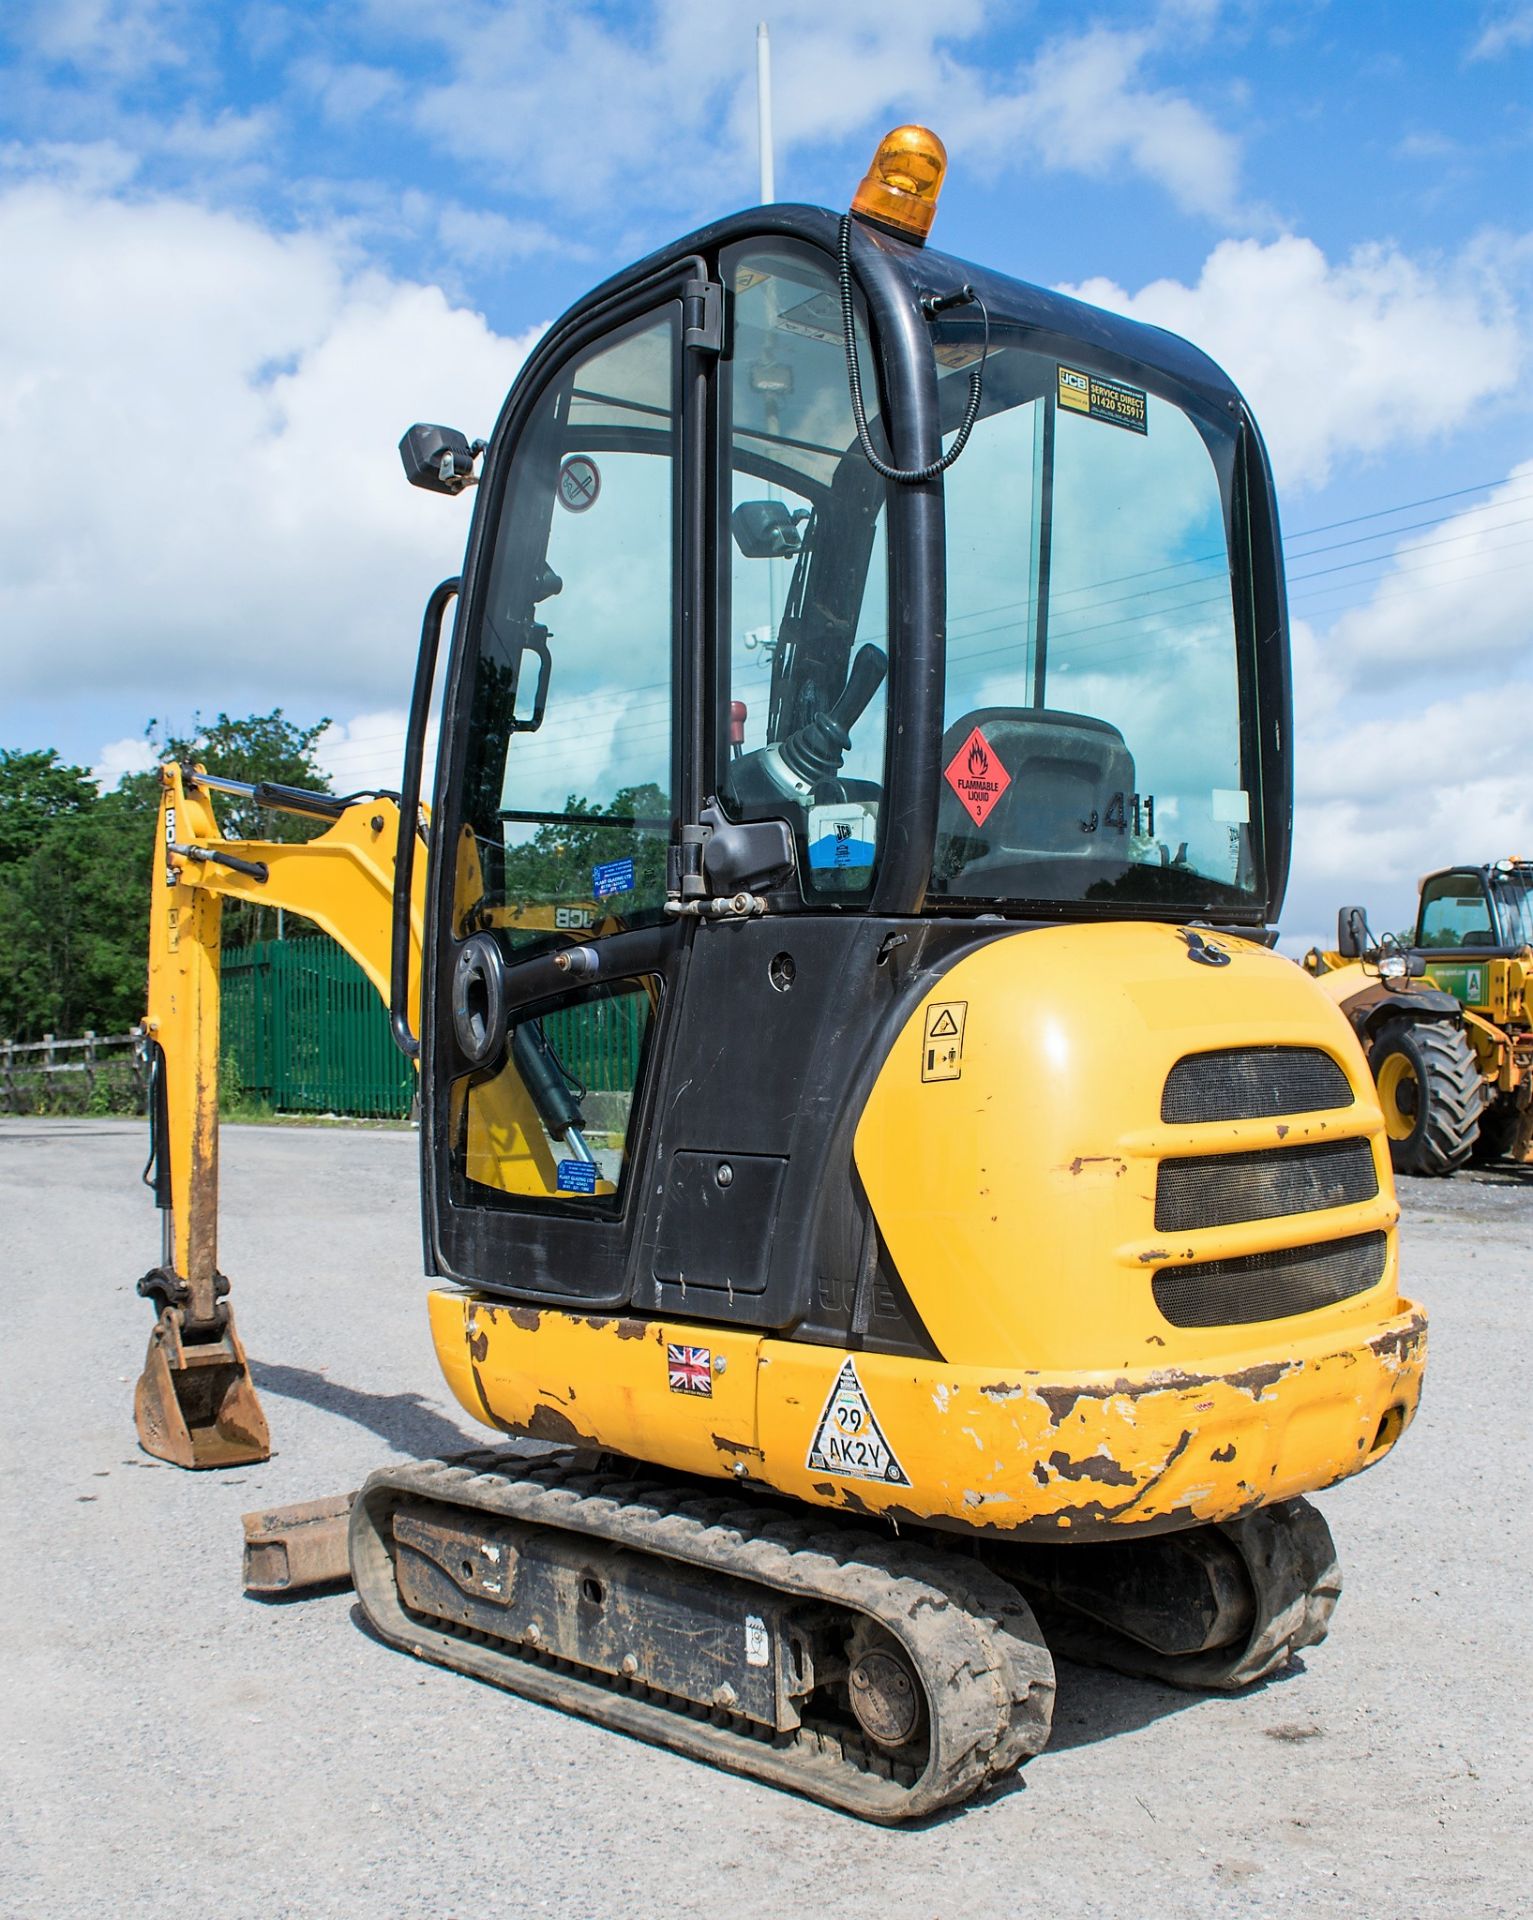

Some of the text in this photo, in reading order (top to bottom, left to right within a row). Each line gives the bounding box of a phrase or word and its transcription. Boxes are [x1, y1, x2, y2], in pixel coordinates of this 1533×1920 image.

[1061, 372, 1086, 390] JCB
[1090, 384, 1119, 400] SERVICE
[1120, 393, 1144, 409] DIRECT
[1091, 394, 1116, 410] 01420
[1117, 404, 1144, 419] 525917
[957, 779, 998, 792] FLAMMABLE
[968, 791, 989, 802] LIQUID
[976, 805, 982, 816] 3
[837, 1407, 861, 1433] 29
[830, 1438, 880, 1468] AK2Y
